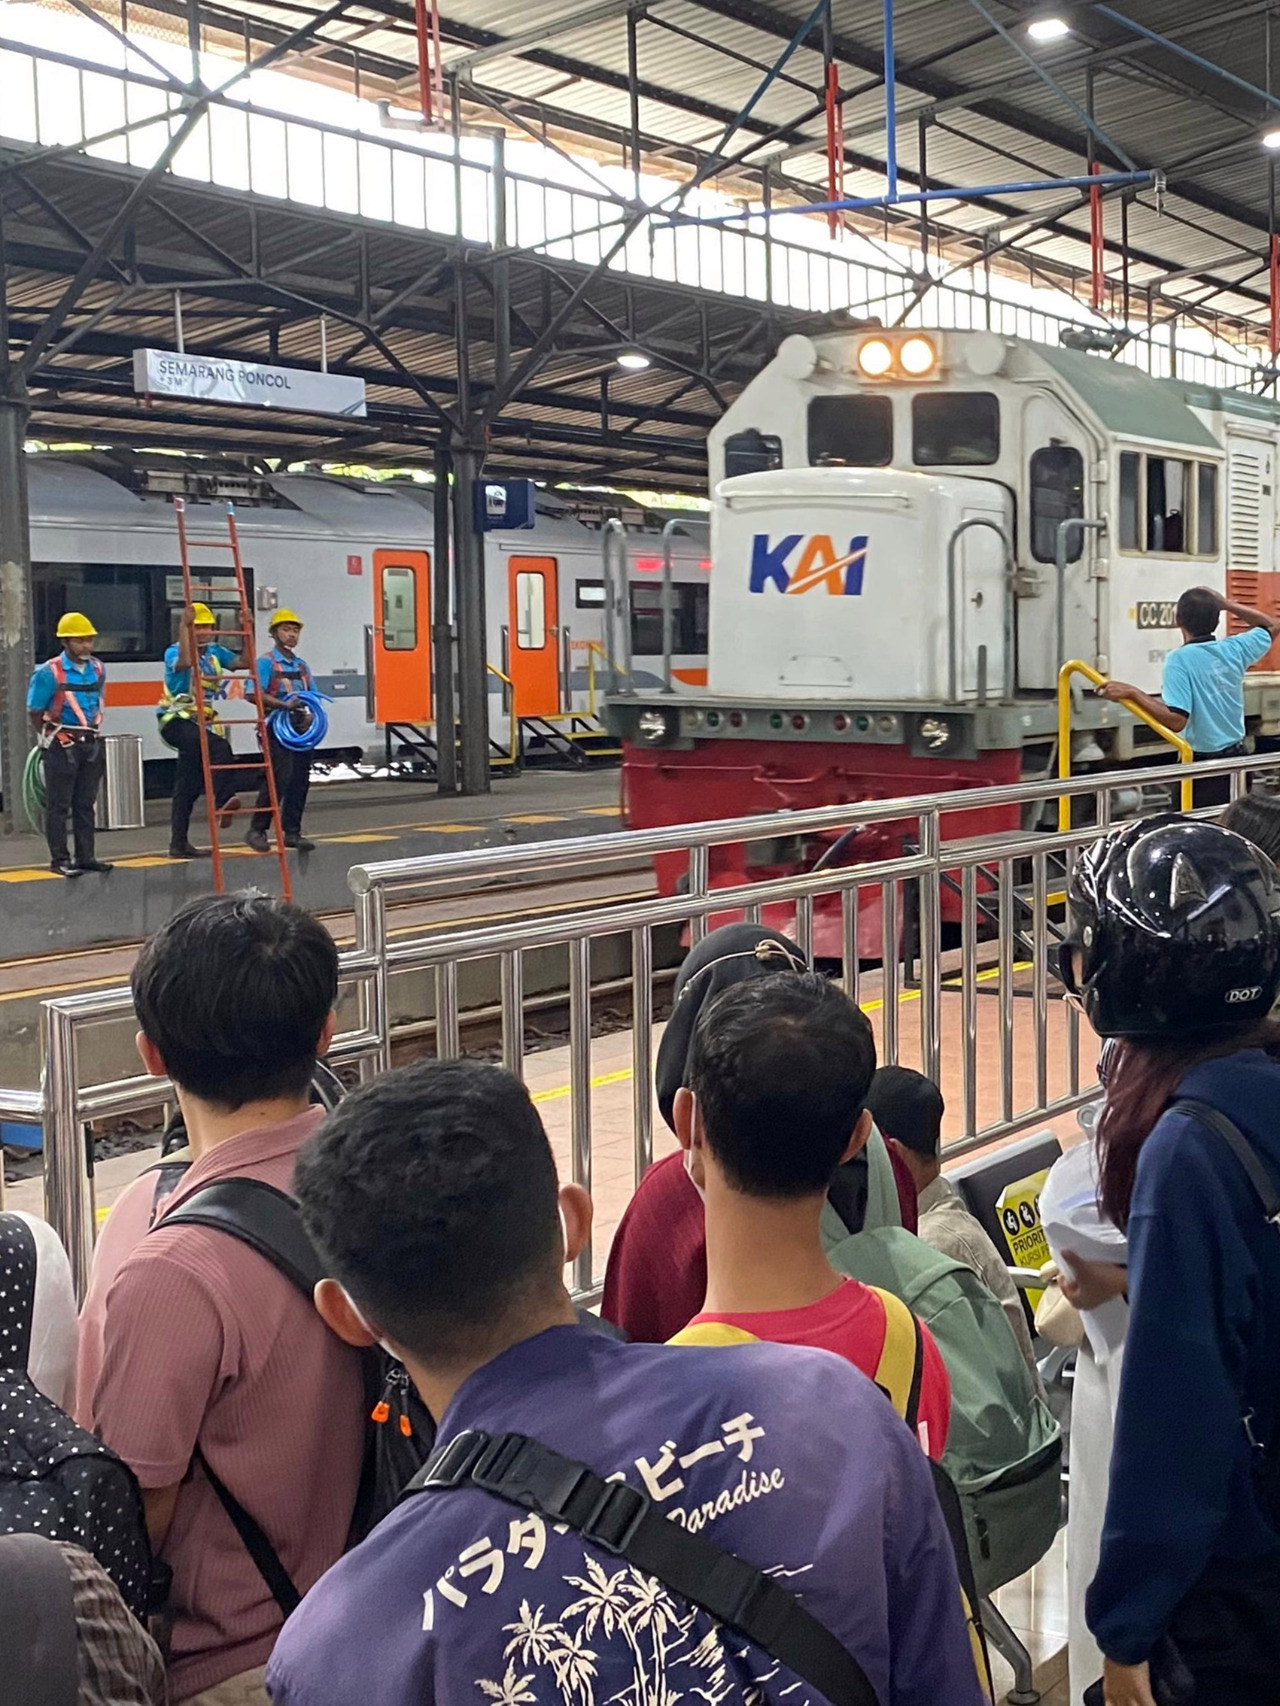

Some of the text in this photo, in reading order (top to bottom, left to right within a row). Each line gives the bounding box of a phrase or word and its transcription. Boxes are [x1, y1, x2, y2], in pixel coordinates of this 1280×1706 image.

[159, 360, 291, 390] SEMARANG PONCOL
[749, 534, 868, 596] KAI
[1139, 603, 1158, 627] CC
[1229, 988, 1259, 1001] DOT
[1012, 1228, 1046, 1256] PRIORIT
